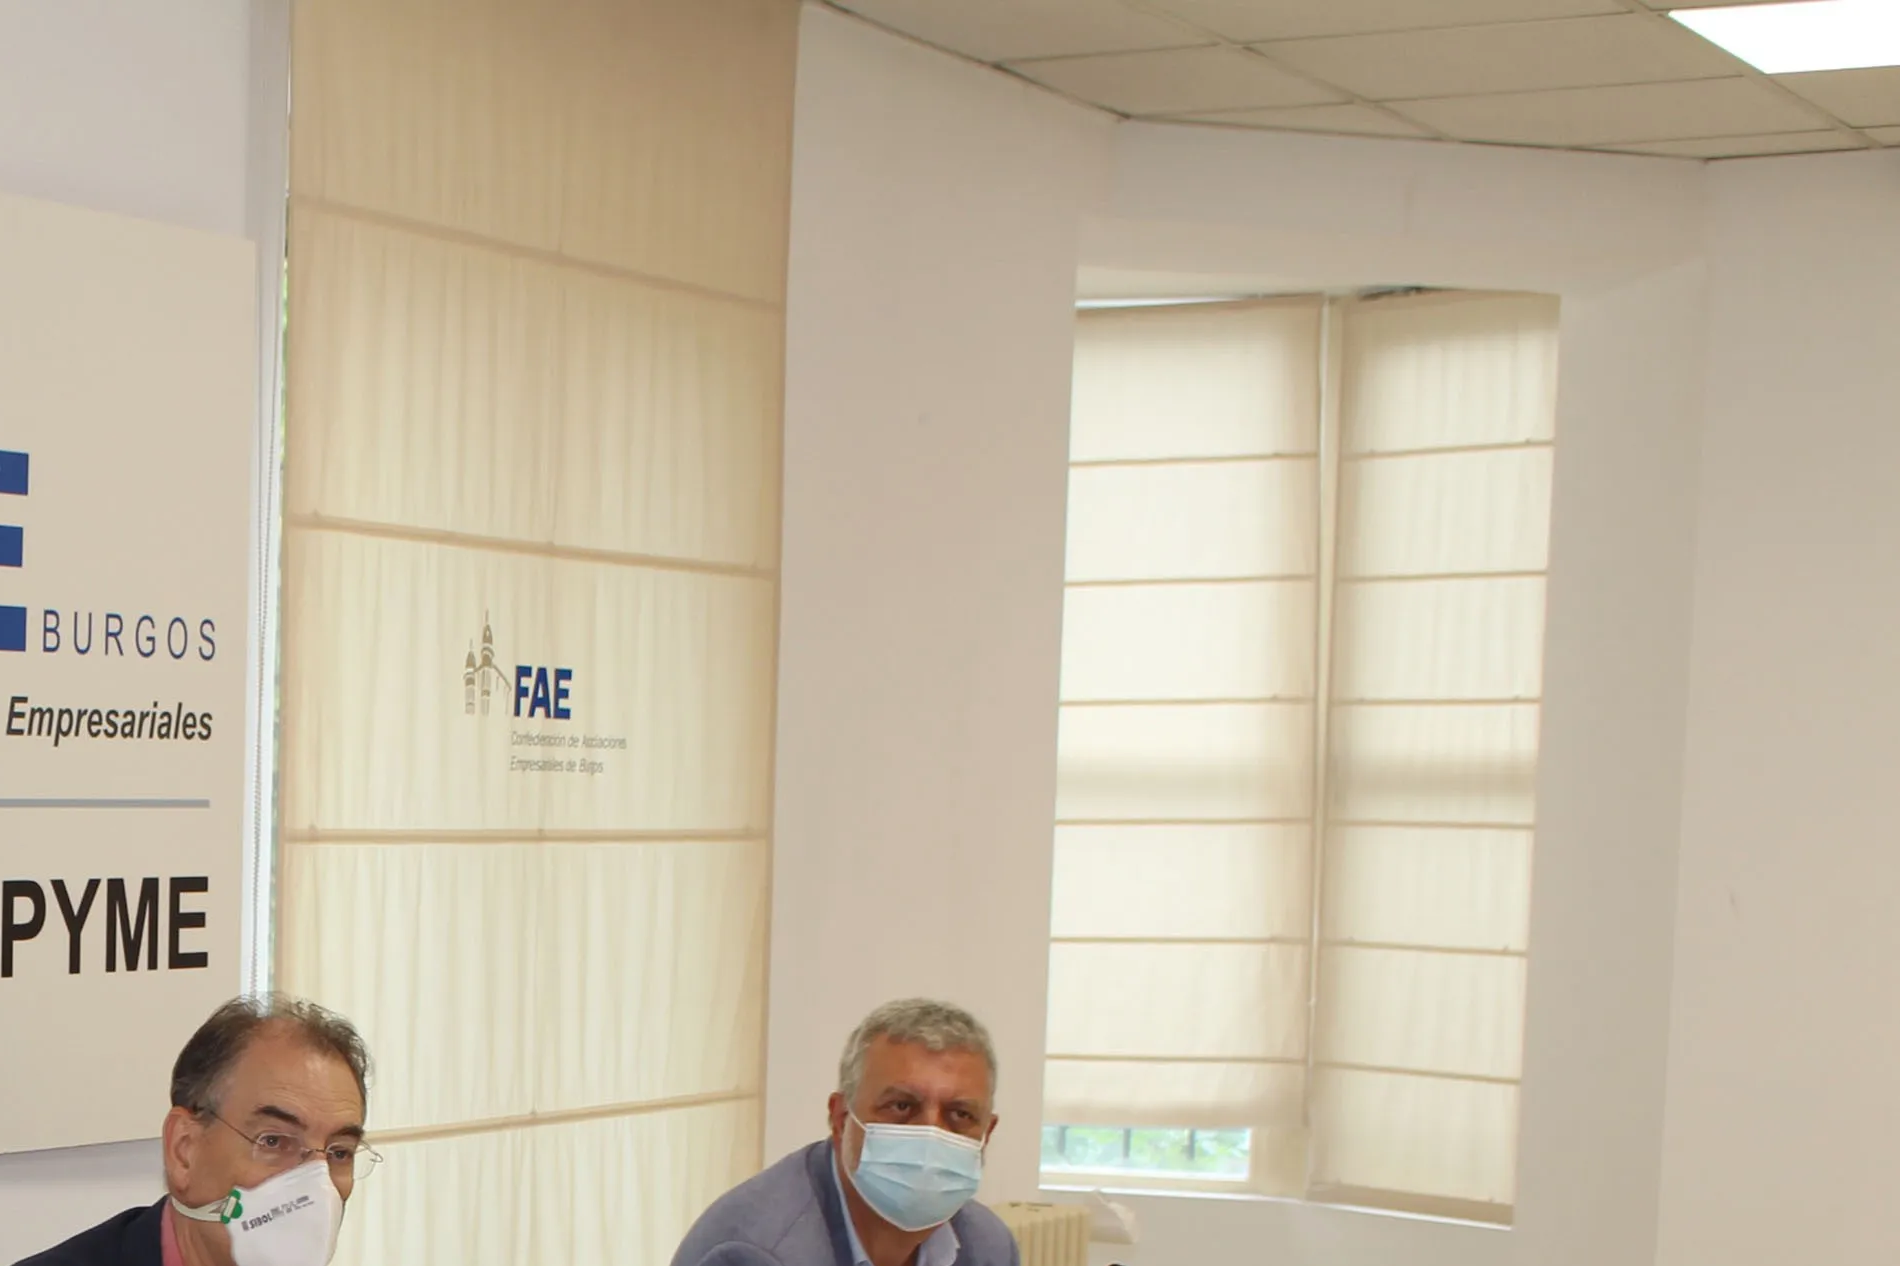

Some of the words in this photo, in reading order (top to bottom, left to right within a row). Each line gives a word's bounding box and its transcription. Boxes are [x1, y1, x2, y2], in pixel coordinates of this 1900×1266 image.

[42, 608, 218, 662] BURGOS
[513, 665, 573, 720] FAE
[6, 696, 214, 748] Empresariales
